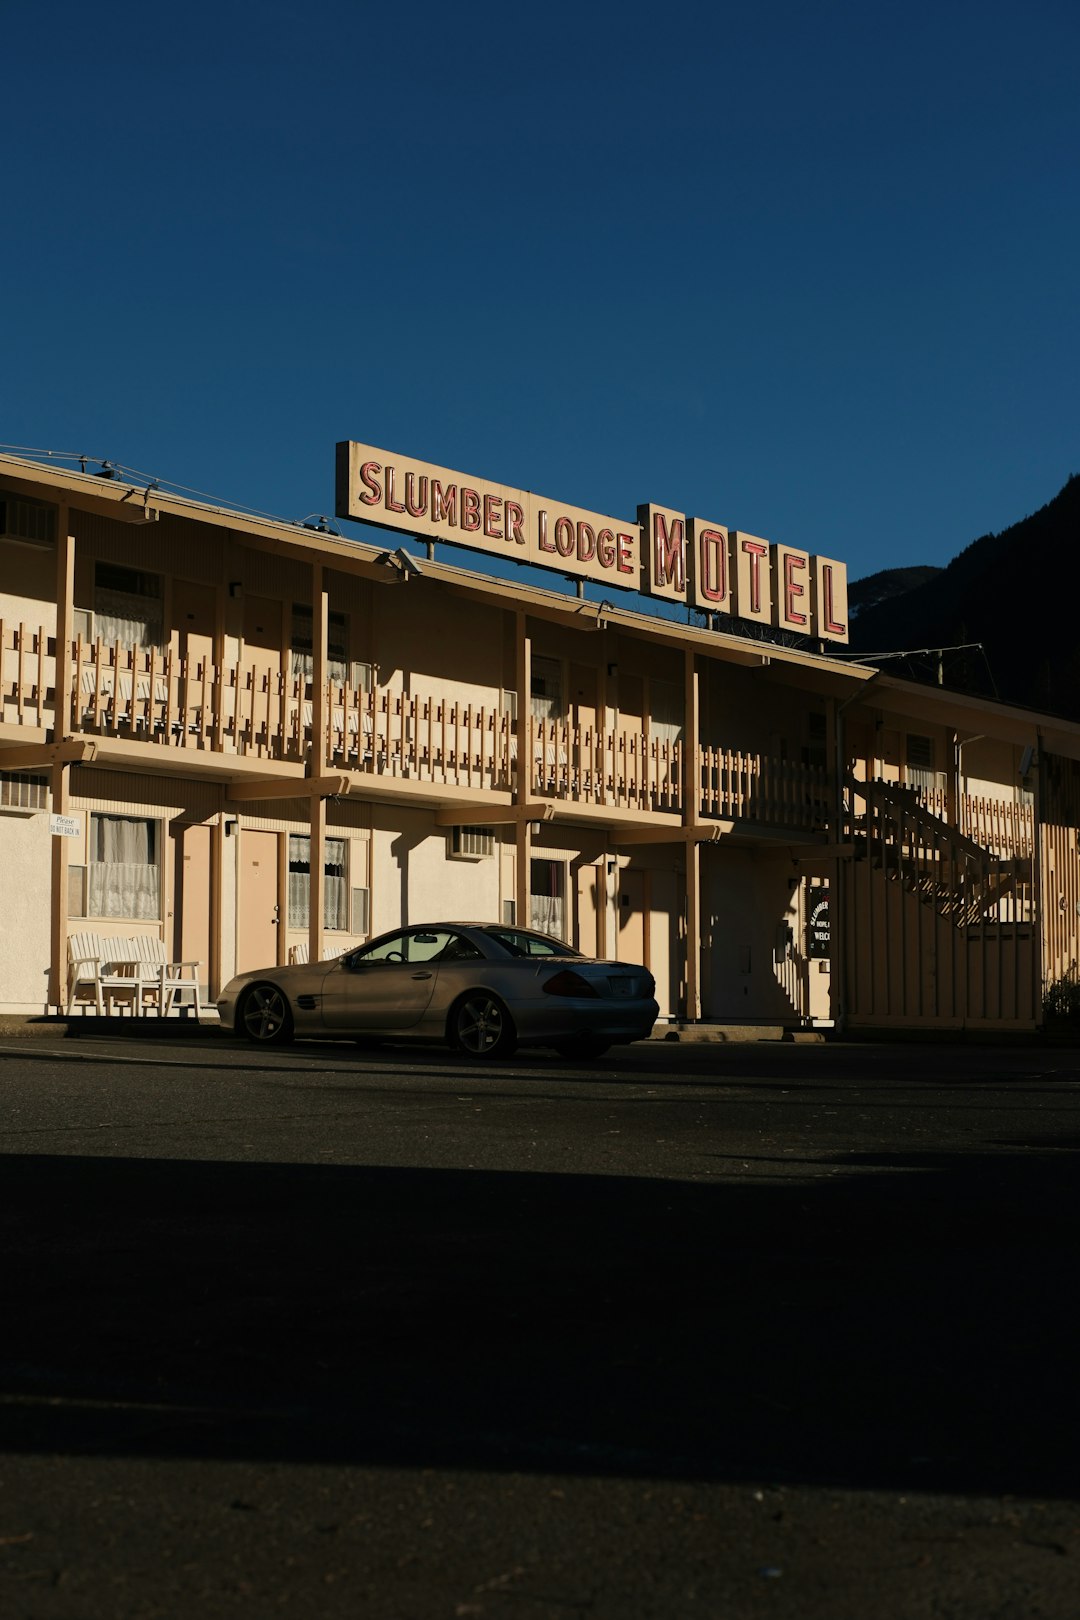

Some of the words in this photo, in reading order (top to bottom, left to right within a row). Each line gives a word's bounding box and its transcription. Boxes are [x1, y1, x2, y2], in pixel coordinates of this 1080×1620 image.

[359, 461, 525, 545] SLUMBER
[538, 510, 635, 575] LODGE
[653, 512, 847, 636] MOTEL
[64, 827, 74, 835] BACK
[810, 901, 829, 927] SLUMBER
